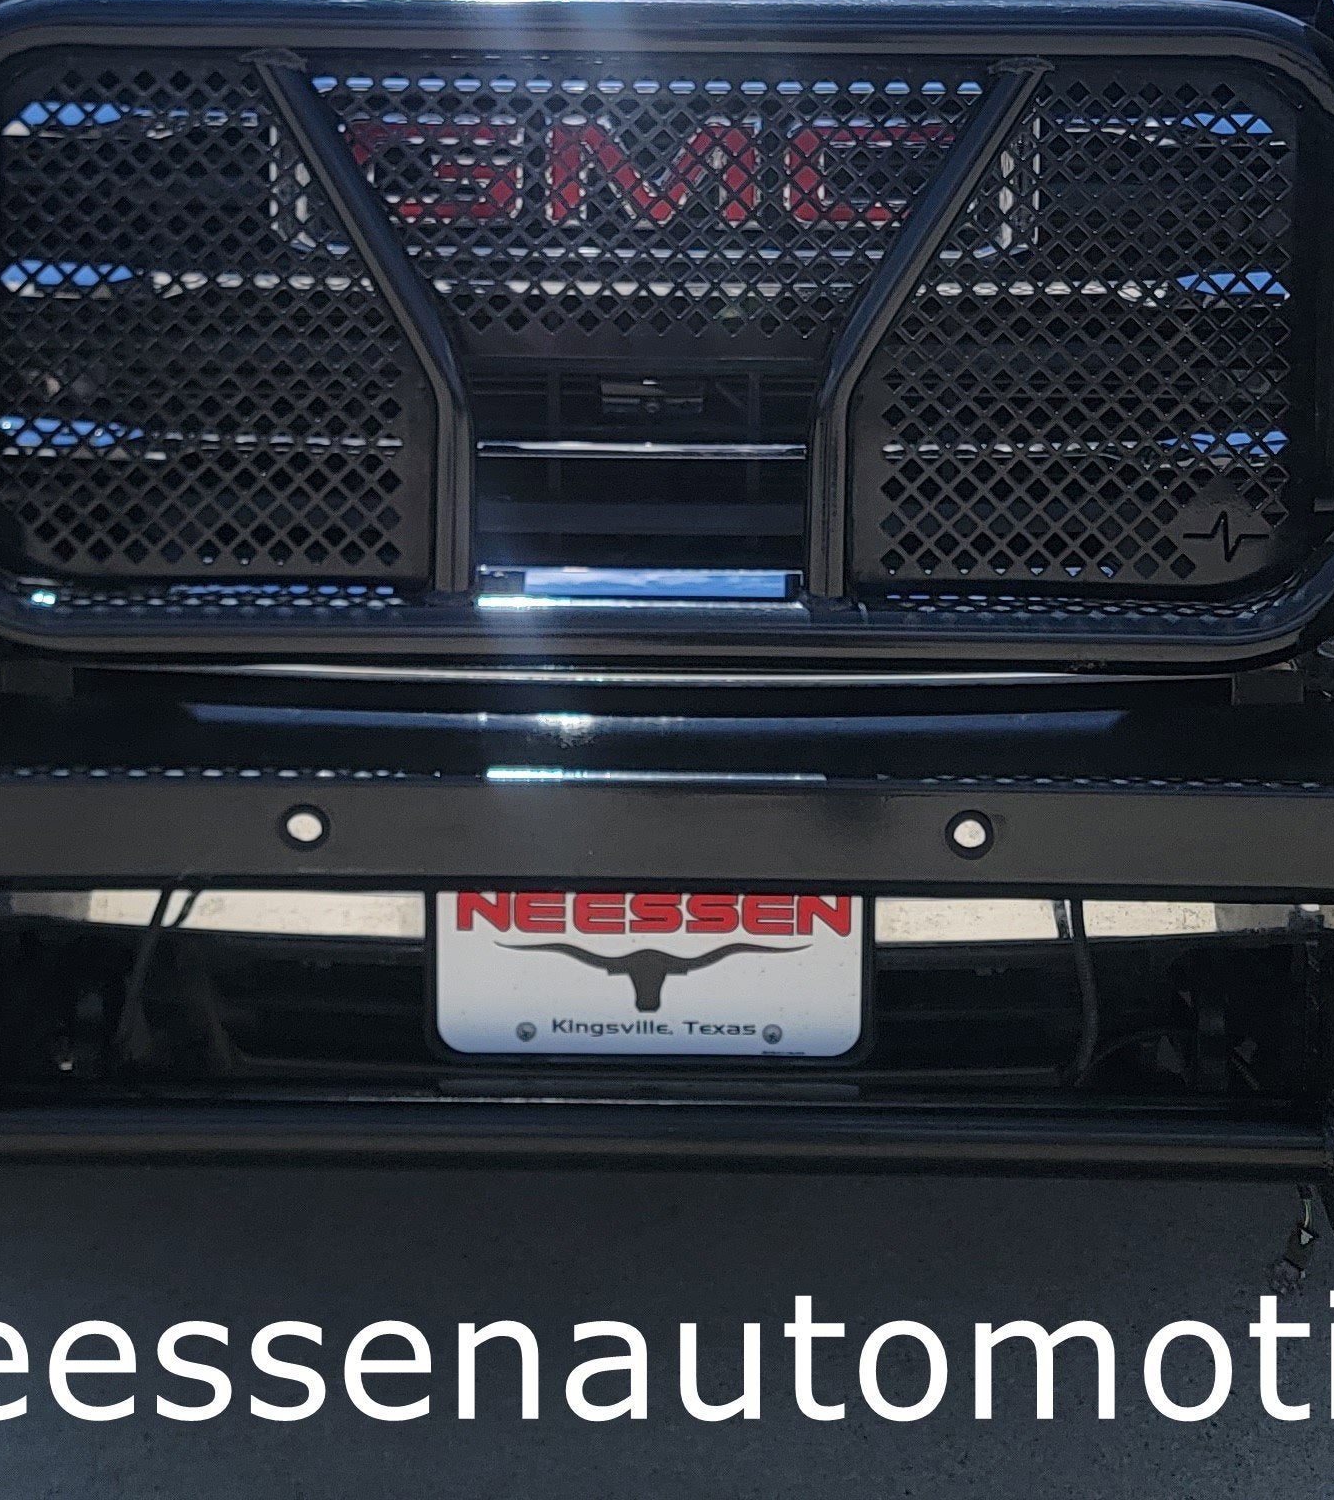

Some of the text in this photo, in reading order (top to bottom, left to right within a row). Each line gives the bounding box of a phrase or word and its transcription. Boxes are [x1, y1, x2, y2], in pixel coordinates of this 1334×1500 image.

[343, 112, 957, 228] GMC
[456, 890, 852, 936] NEESSEN
[682, 1020, 756, 1036] Texas
